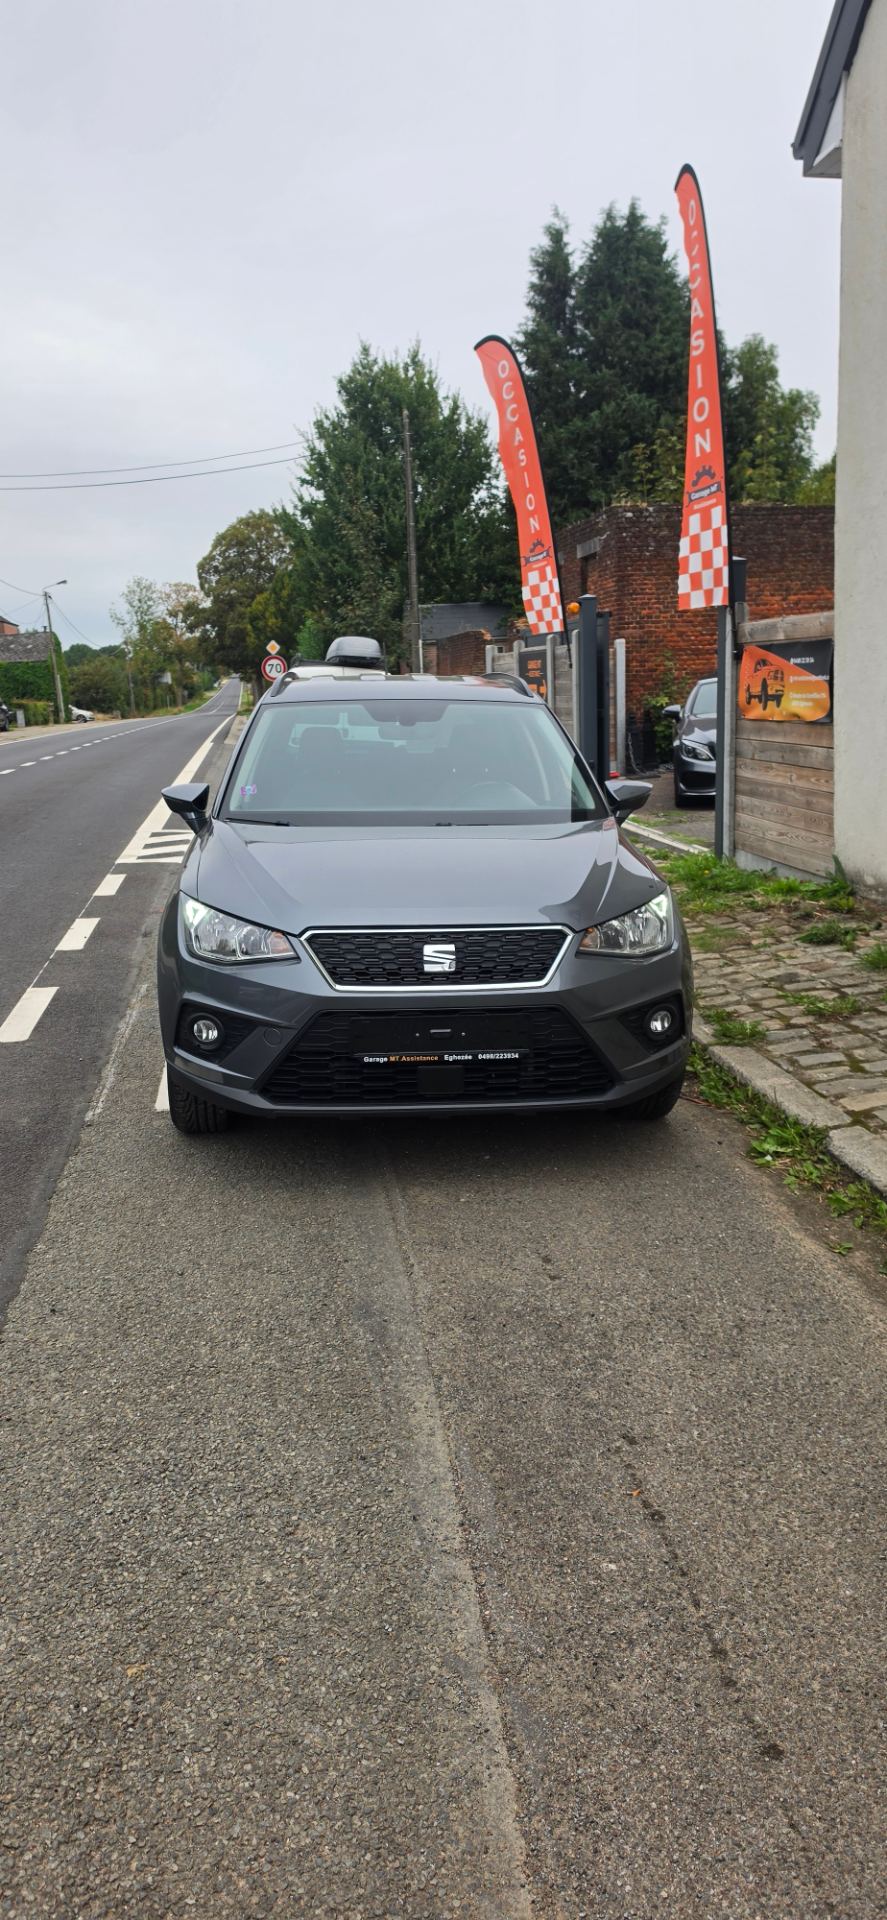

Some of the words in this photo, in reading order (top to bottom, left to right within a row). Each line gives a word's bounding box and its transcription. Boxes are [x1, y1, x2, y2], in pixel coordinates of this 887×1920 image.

[498, 360, 540, 534] OCCASION
[268, 664, 282, 673] 70
[444, 1053, 473, 1062] Eghezée
